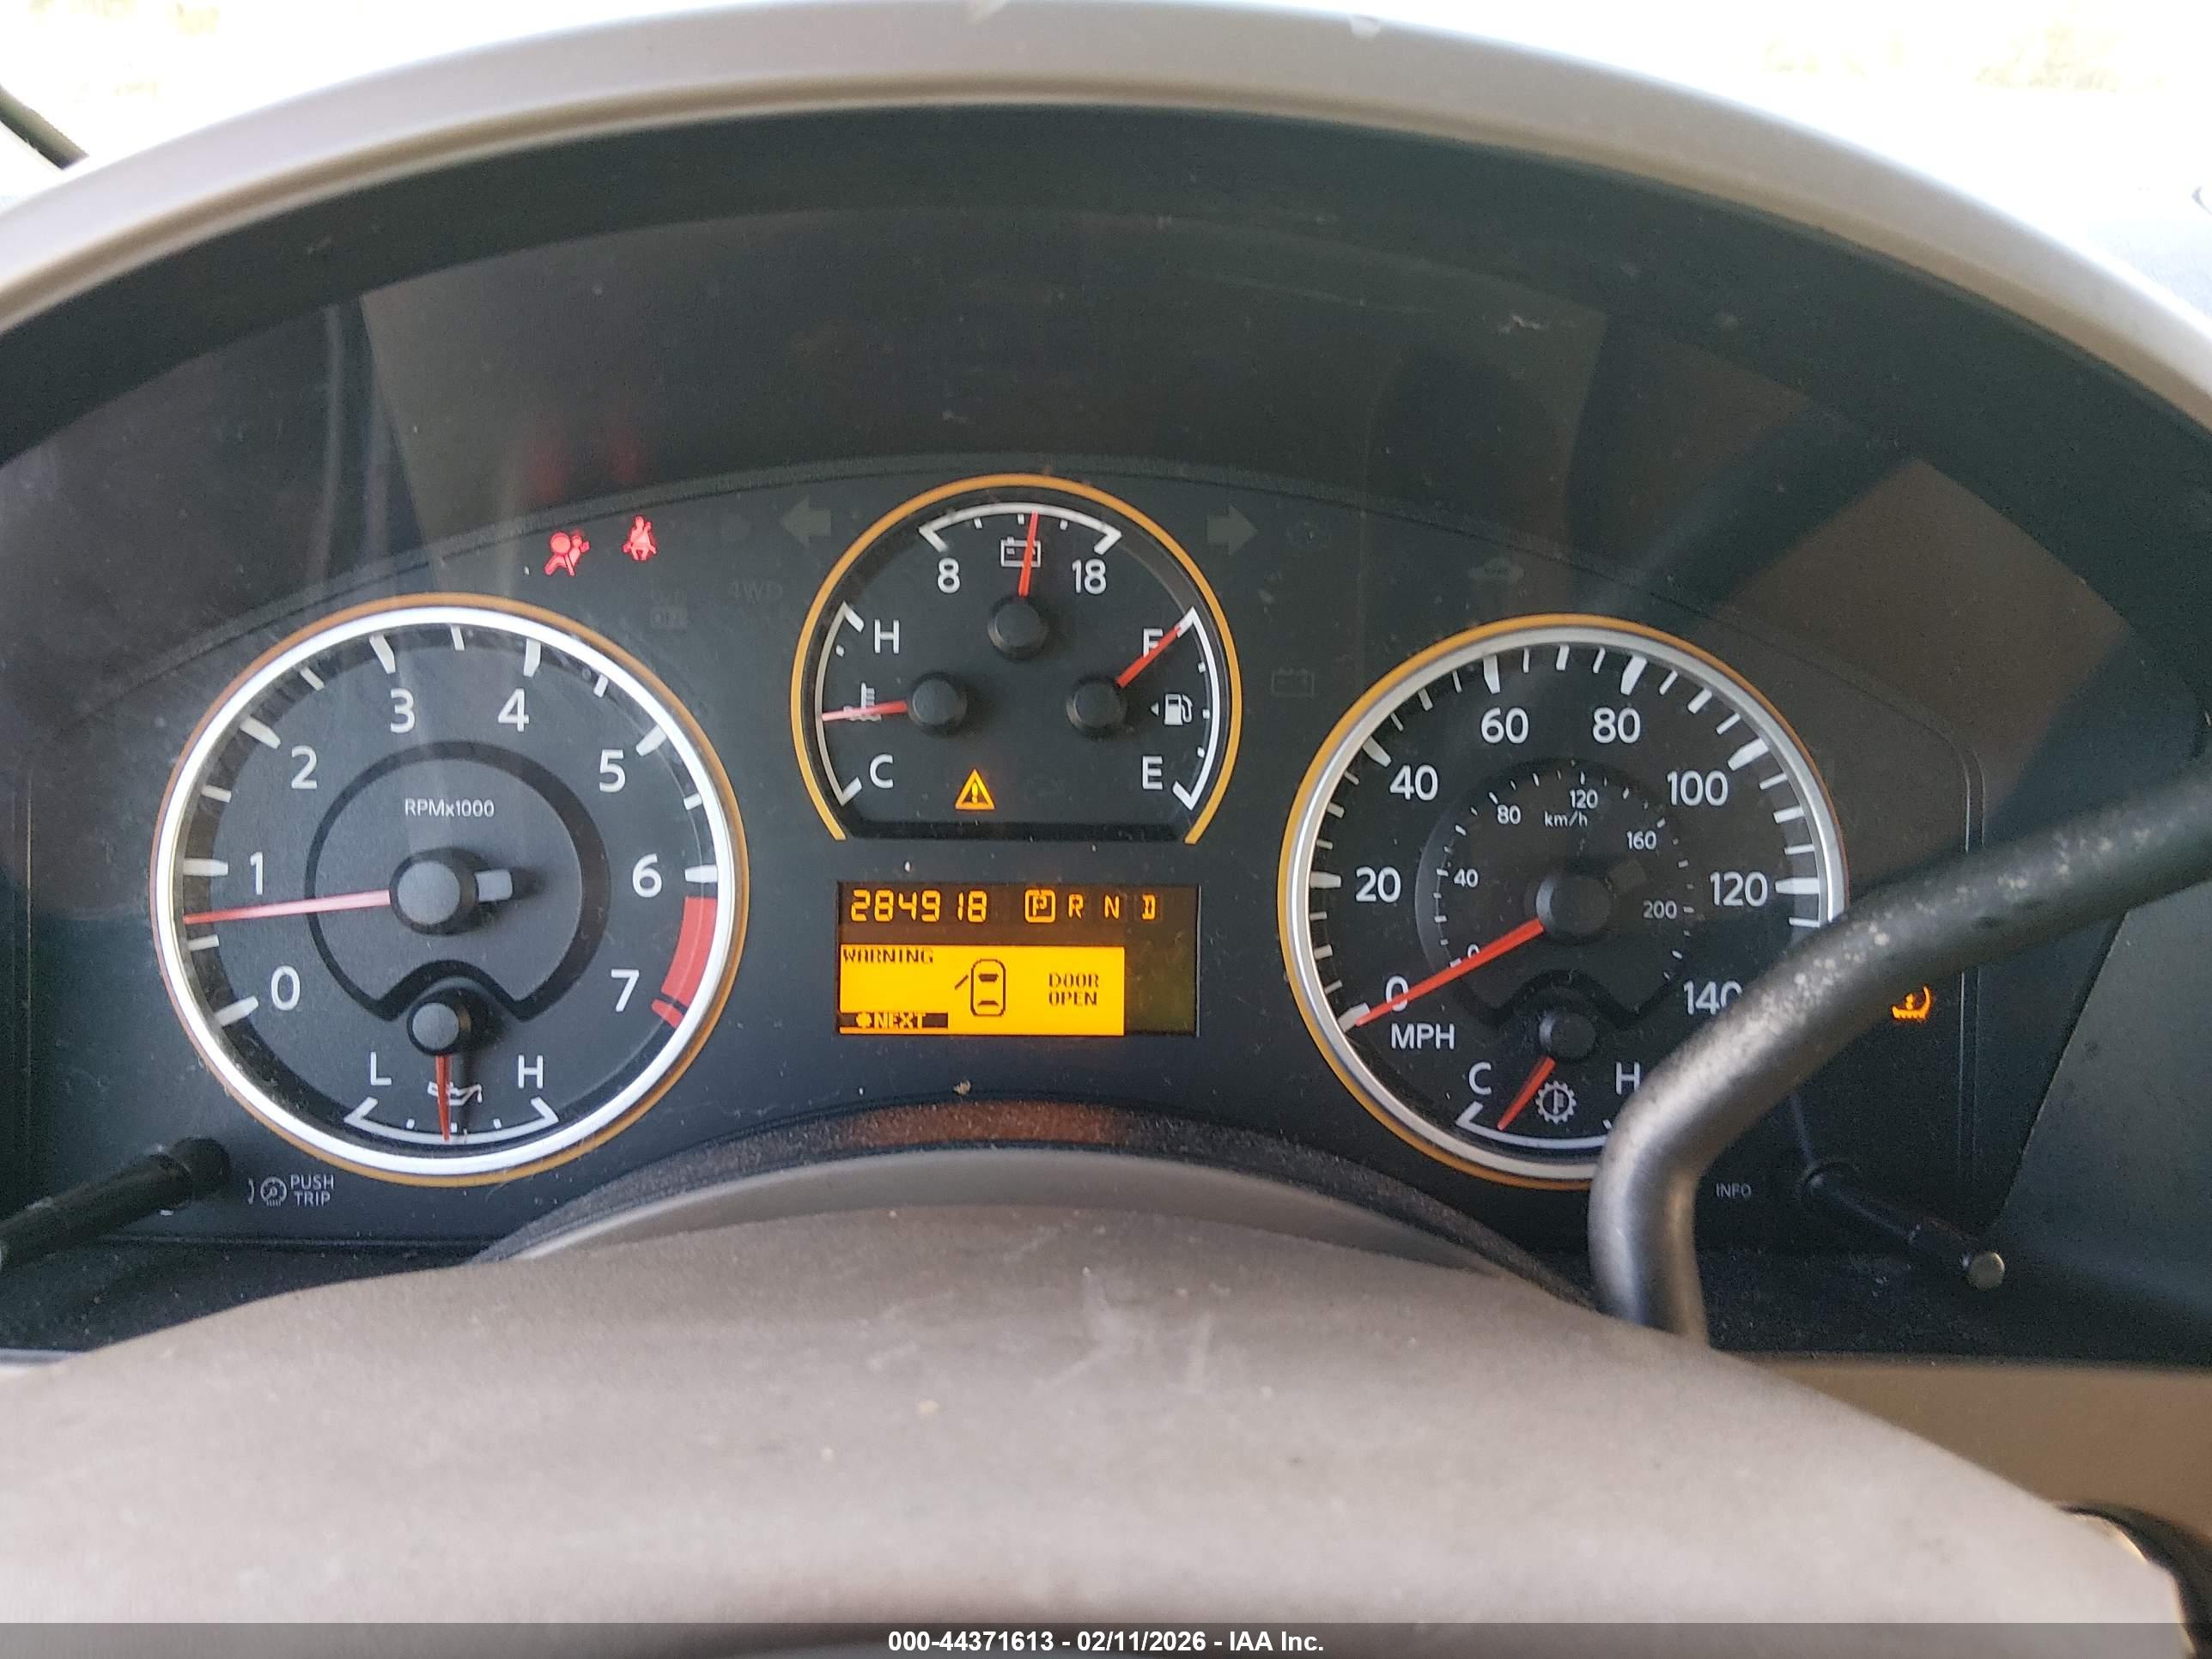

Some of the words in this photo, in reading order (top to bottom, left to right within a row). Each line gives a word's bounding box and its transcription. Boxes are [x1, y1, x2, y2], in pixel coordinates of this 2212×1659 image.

[938, 558, 961, 593] 8
[1072, 559, 1107, 593] 18
[873, 619, 900, 653] H
[1142, 629, 1164, 658] F
[390, 690, 416, 733] 3
[498, 689, 530, 732] 4
[1480, 708, 1529, 744] 60
[1592, 708, 1641, 744] 80
[290, 745, 319, 790] 2
[599, 750, 626, 793] 5
[869, 755, 894, 789] C
[1142, 756, 1164, 790] E
[1389, 765, 1438, 800] 40
[1570, 789, 1599, 810] 120
[1667, 771, 1729, 807] 100
[404, 798, 495, 819] RPMx1000
[1497, 805, 1521, 824] 80
[1544, 811, 1589, 829] km/h
[1626, 830, 1657, 850] 160
[248, 852, 264, 896] 1
[632, 854, 662, 898] 6
[1355, 866, 1401, 903] 20
[1454, 869, 1479, 888] 40
[1709, 871, 1769, 907] 120
[850, 889, 988, 922] 284918
[1068, 893, 1085, 919] R
[1104, 895, 1120, 919] N
[1142, 894, 1157, 920] D
[1643, 900, 1677, 919] 200
[843, 949, 934, 963] WARNING
[270, 965, 301, 1010] 0
[611, 969, 640, 1012] 7
[1048, 973, 1099, 988] DOOR
[1385, 975, 1409, 1012] 0
[1048, 991, 1097, 1006] OPEN
[874, 1012, 926, 1029] NEXT
[1391, 1023, 1455, 1049] MPH
[369, 1053, 392, 1085] L
[517, 1054, 544, 1087] H
[1468, 1061, 1492, 1094] C
[1616, 1061, 1640, 1095] H
[290, 1174, 334, 1190] PUSH
[294, 1190, 331, 1206] TRIP
[1717, 1183, 1751, 1199] INFO
